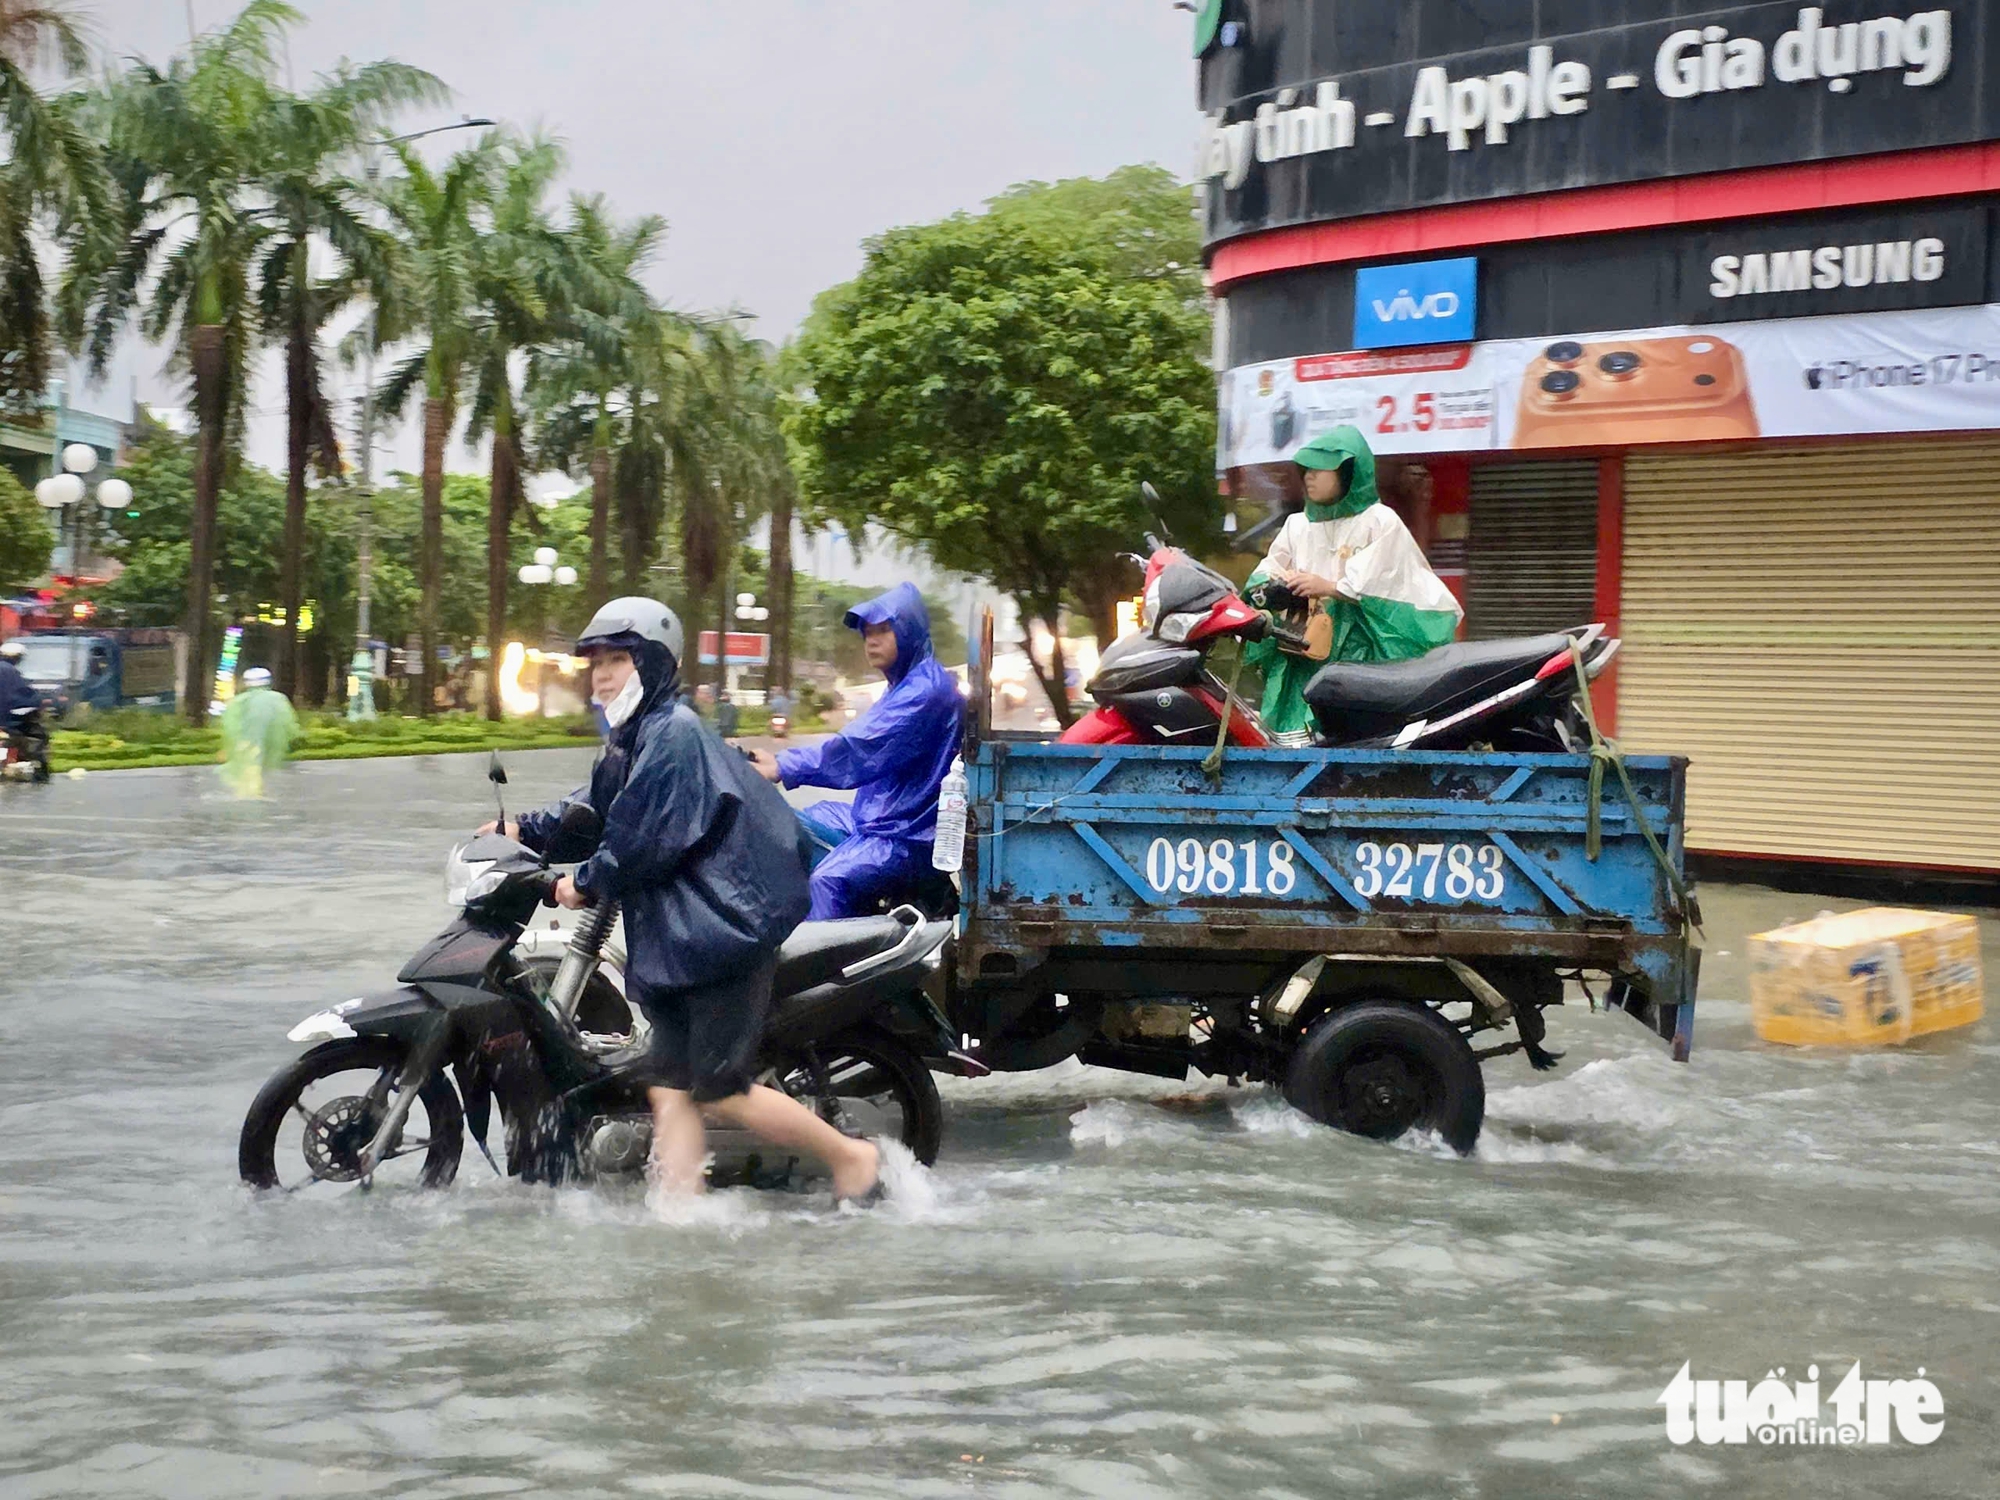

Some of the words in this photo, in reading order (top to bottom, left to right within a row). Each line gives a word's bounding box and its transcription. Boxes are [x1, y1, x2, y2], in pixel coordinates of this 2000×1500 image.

[1255, 82, 1356, 162] tính
[1404, 45, 1592, 151] Apple
[1654, 25, 1765, 98] Gia
[1772, 7, 1952, 93] dụng
[1709, 237, 1945, 298] SAMSUNG
[1372, 288, 1459, 322] vivo
[1822, 360, 1926, 390] iPhone
[1927, 353, 1962, 384] 17
[1375, 393, 1437, 434] 2.5
[1146, 837, 1296, 896] 09818
[1353, 841, 1504, 900] 32783
